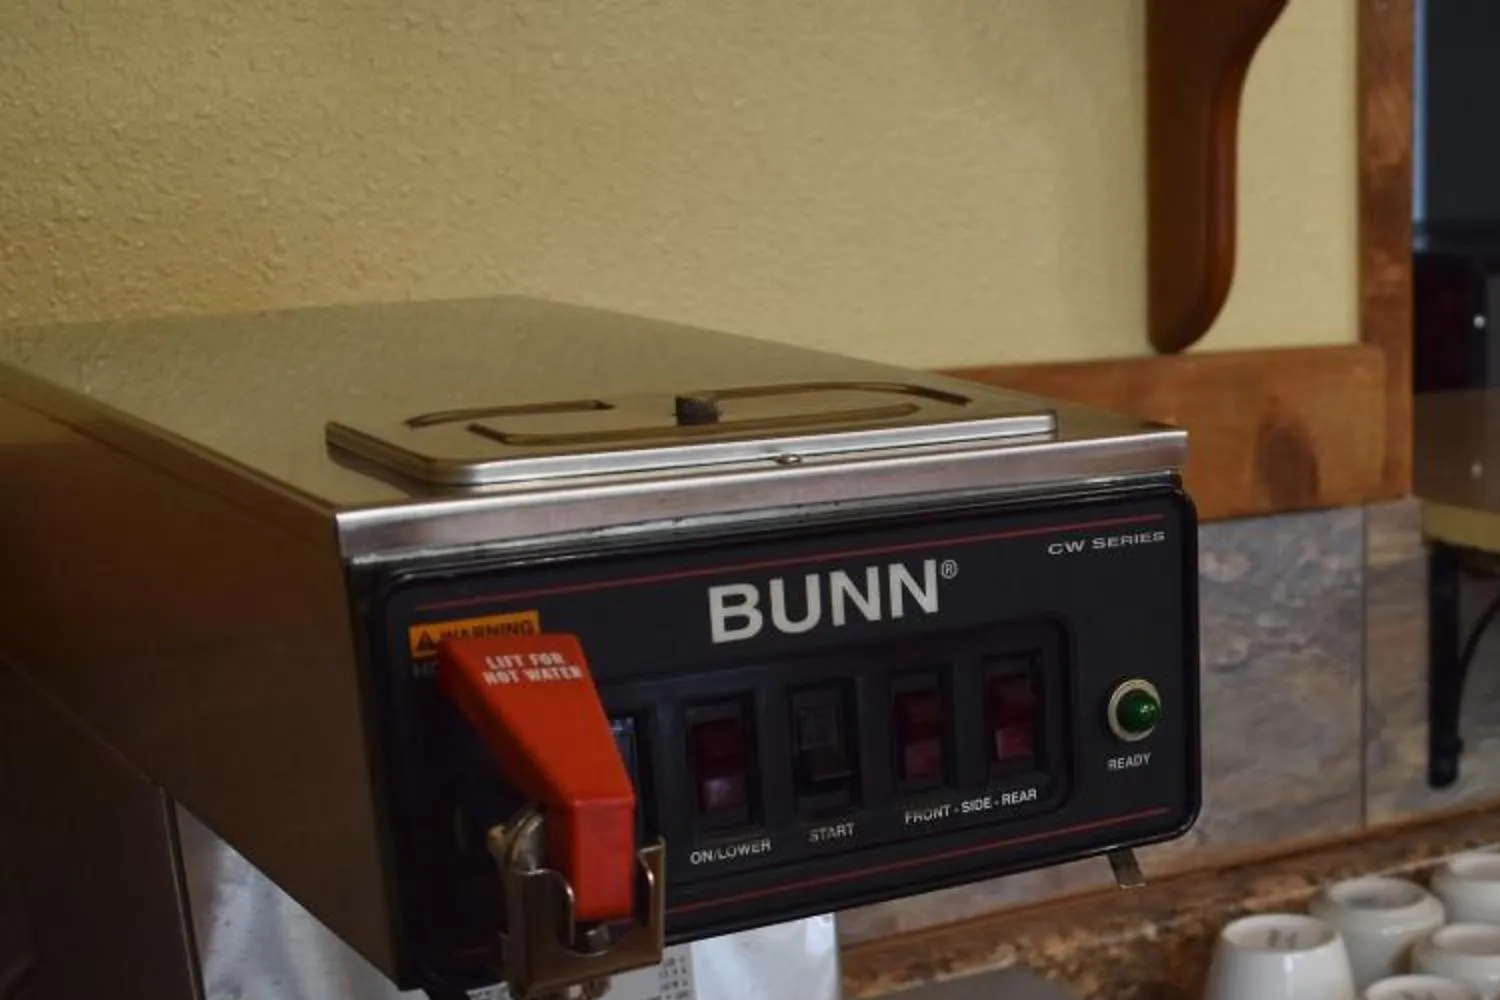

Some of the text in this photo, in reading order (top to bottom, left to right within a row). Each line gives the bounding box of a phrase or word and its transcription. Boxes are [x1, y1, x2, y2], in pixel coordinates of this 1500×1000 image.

[1047, 531, 1166, 555] CW SERIES
[484, 651, 564, 671] LIFT FOR
[481, 665, 584, 687] HOT WATER
[1107, 752, 1152, 772] READY
[904, 788, 1038, 825] FRONT SIDE REAR
[808, 822, 855, 844] START
[689, 838, 772, 866] ON/LOWER
